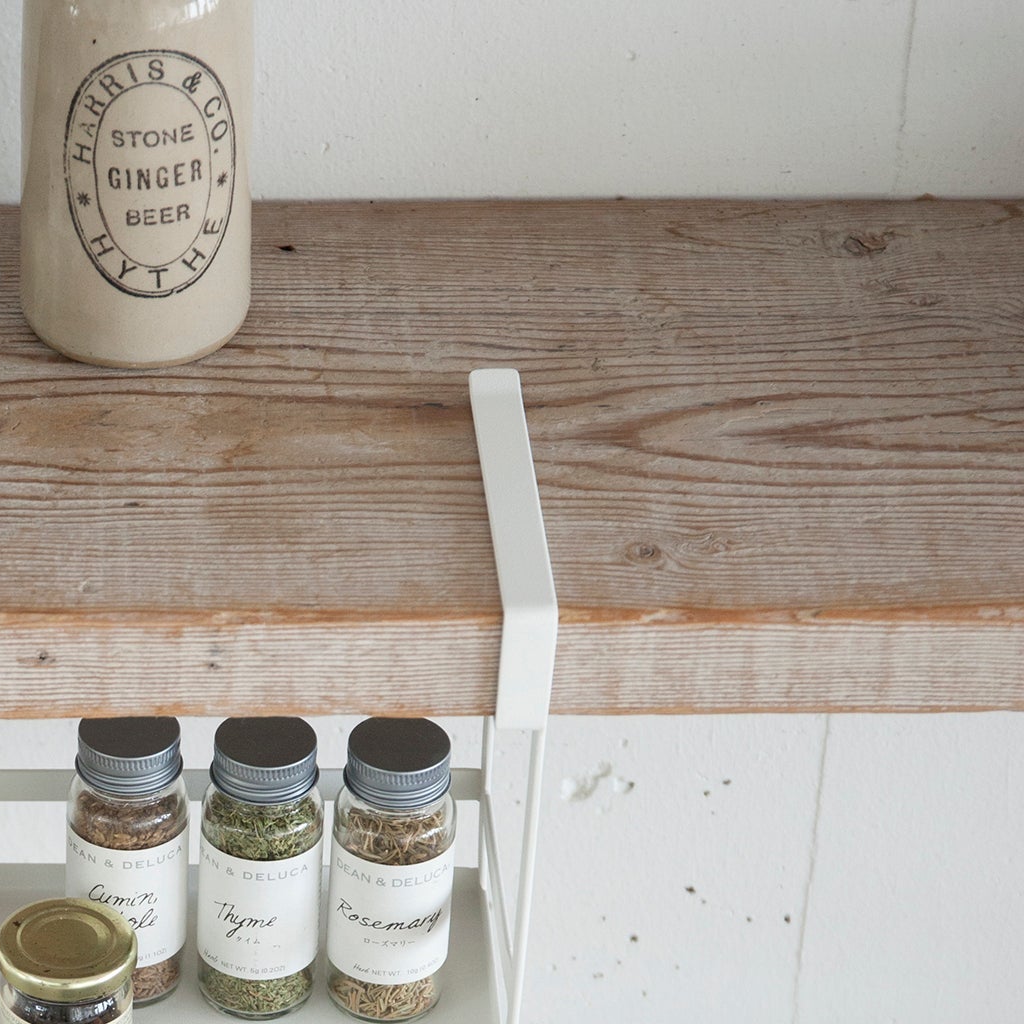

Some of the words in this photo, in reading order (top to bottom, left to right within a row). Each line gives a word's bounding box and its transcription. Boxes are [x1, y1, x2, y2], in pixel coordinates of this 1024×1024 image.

[72, 59, 165, 166] HARRIS
[182, 71, 202, 94] &
[111, 123, 195, 148] STONE
[108, 158, 203, 190] GINGER
[125, 203, 191, 227] BEER
[89, 217, 224, 289] HYTHE
[104, 859, 114, 868] &
[122, 845, 183, 870] DELUCA
[226, 867, 235, 876] &
[243, 864, 308, 881] DELUCA
[336, 858, 371, 884] DEAN
[376, 877, 386, 887] &
[392, 864, 449, 888] DELUCA
[214, 901, 278, 938] Thyme
[337, 898, 442, 934] Rosemary
